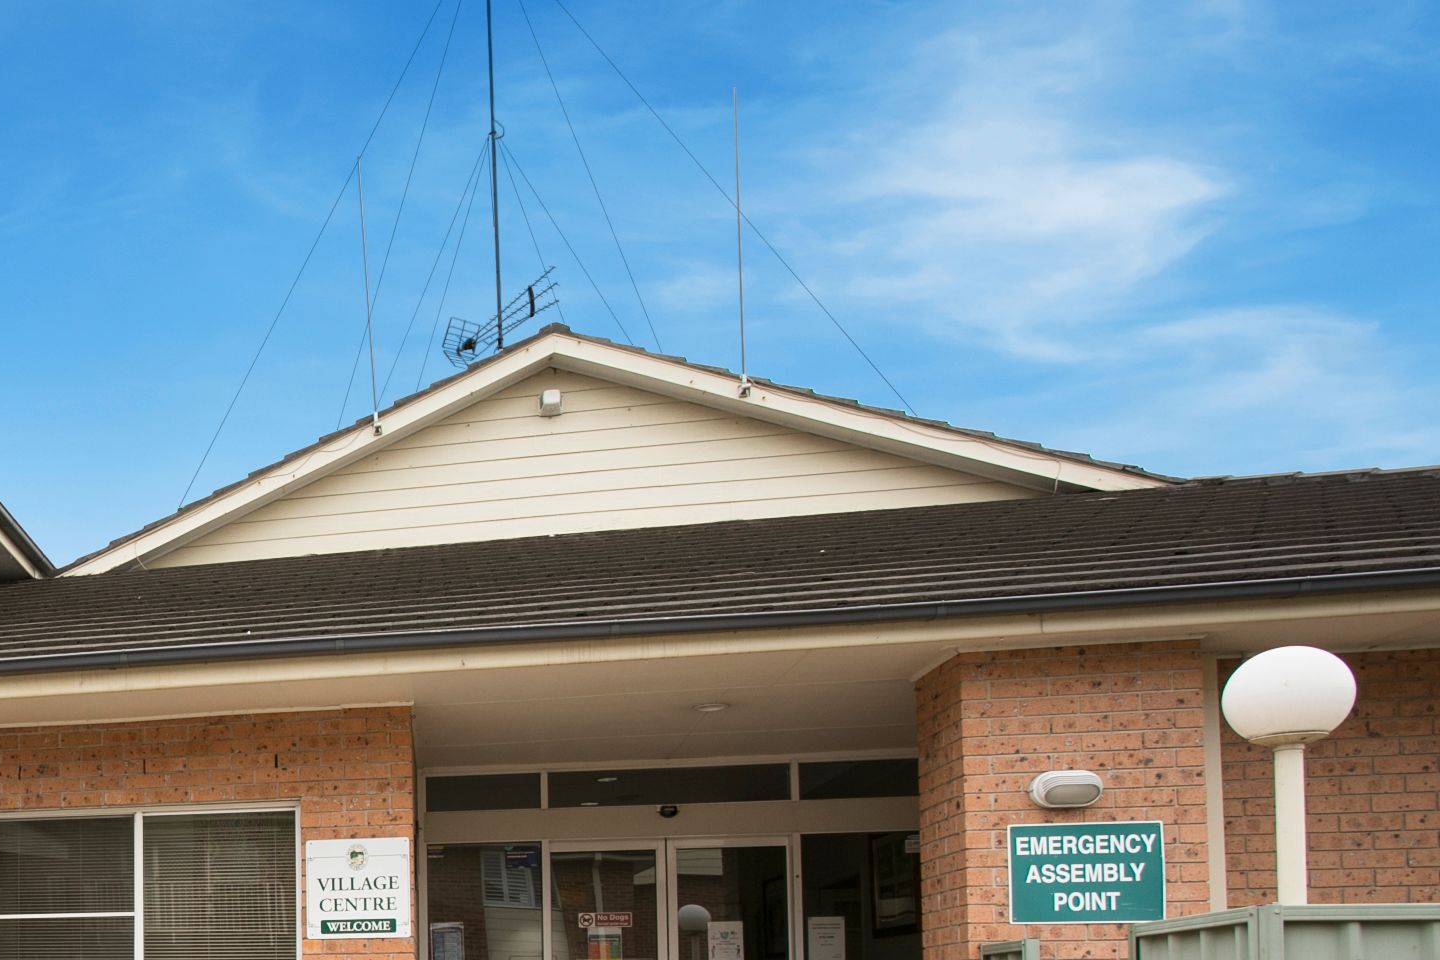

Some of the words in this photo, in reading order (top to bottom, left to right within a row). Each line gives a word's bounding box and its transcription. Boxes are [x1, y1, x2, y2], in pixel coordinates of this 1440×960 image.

[1015, 833, 1156, 856] EMERGENCY
[1026, 862, 1145, 884] ASSEMBLY
[317, 876, 400, 892] VILLAGE
[319, 896, 397, 912] CENTRE
[1053, 891, 1121, 912] POINT
[326, 920, 391, 932] WELCOME
[610, 914, 629, 922] Dogs
